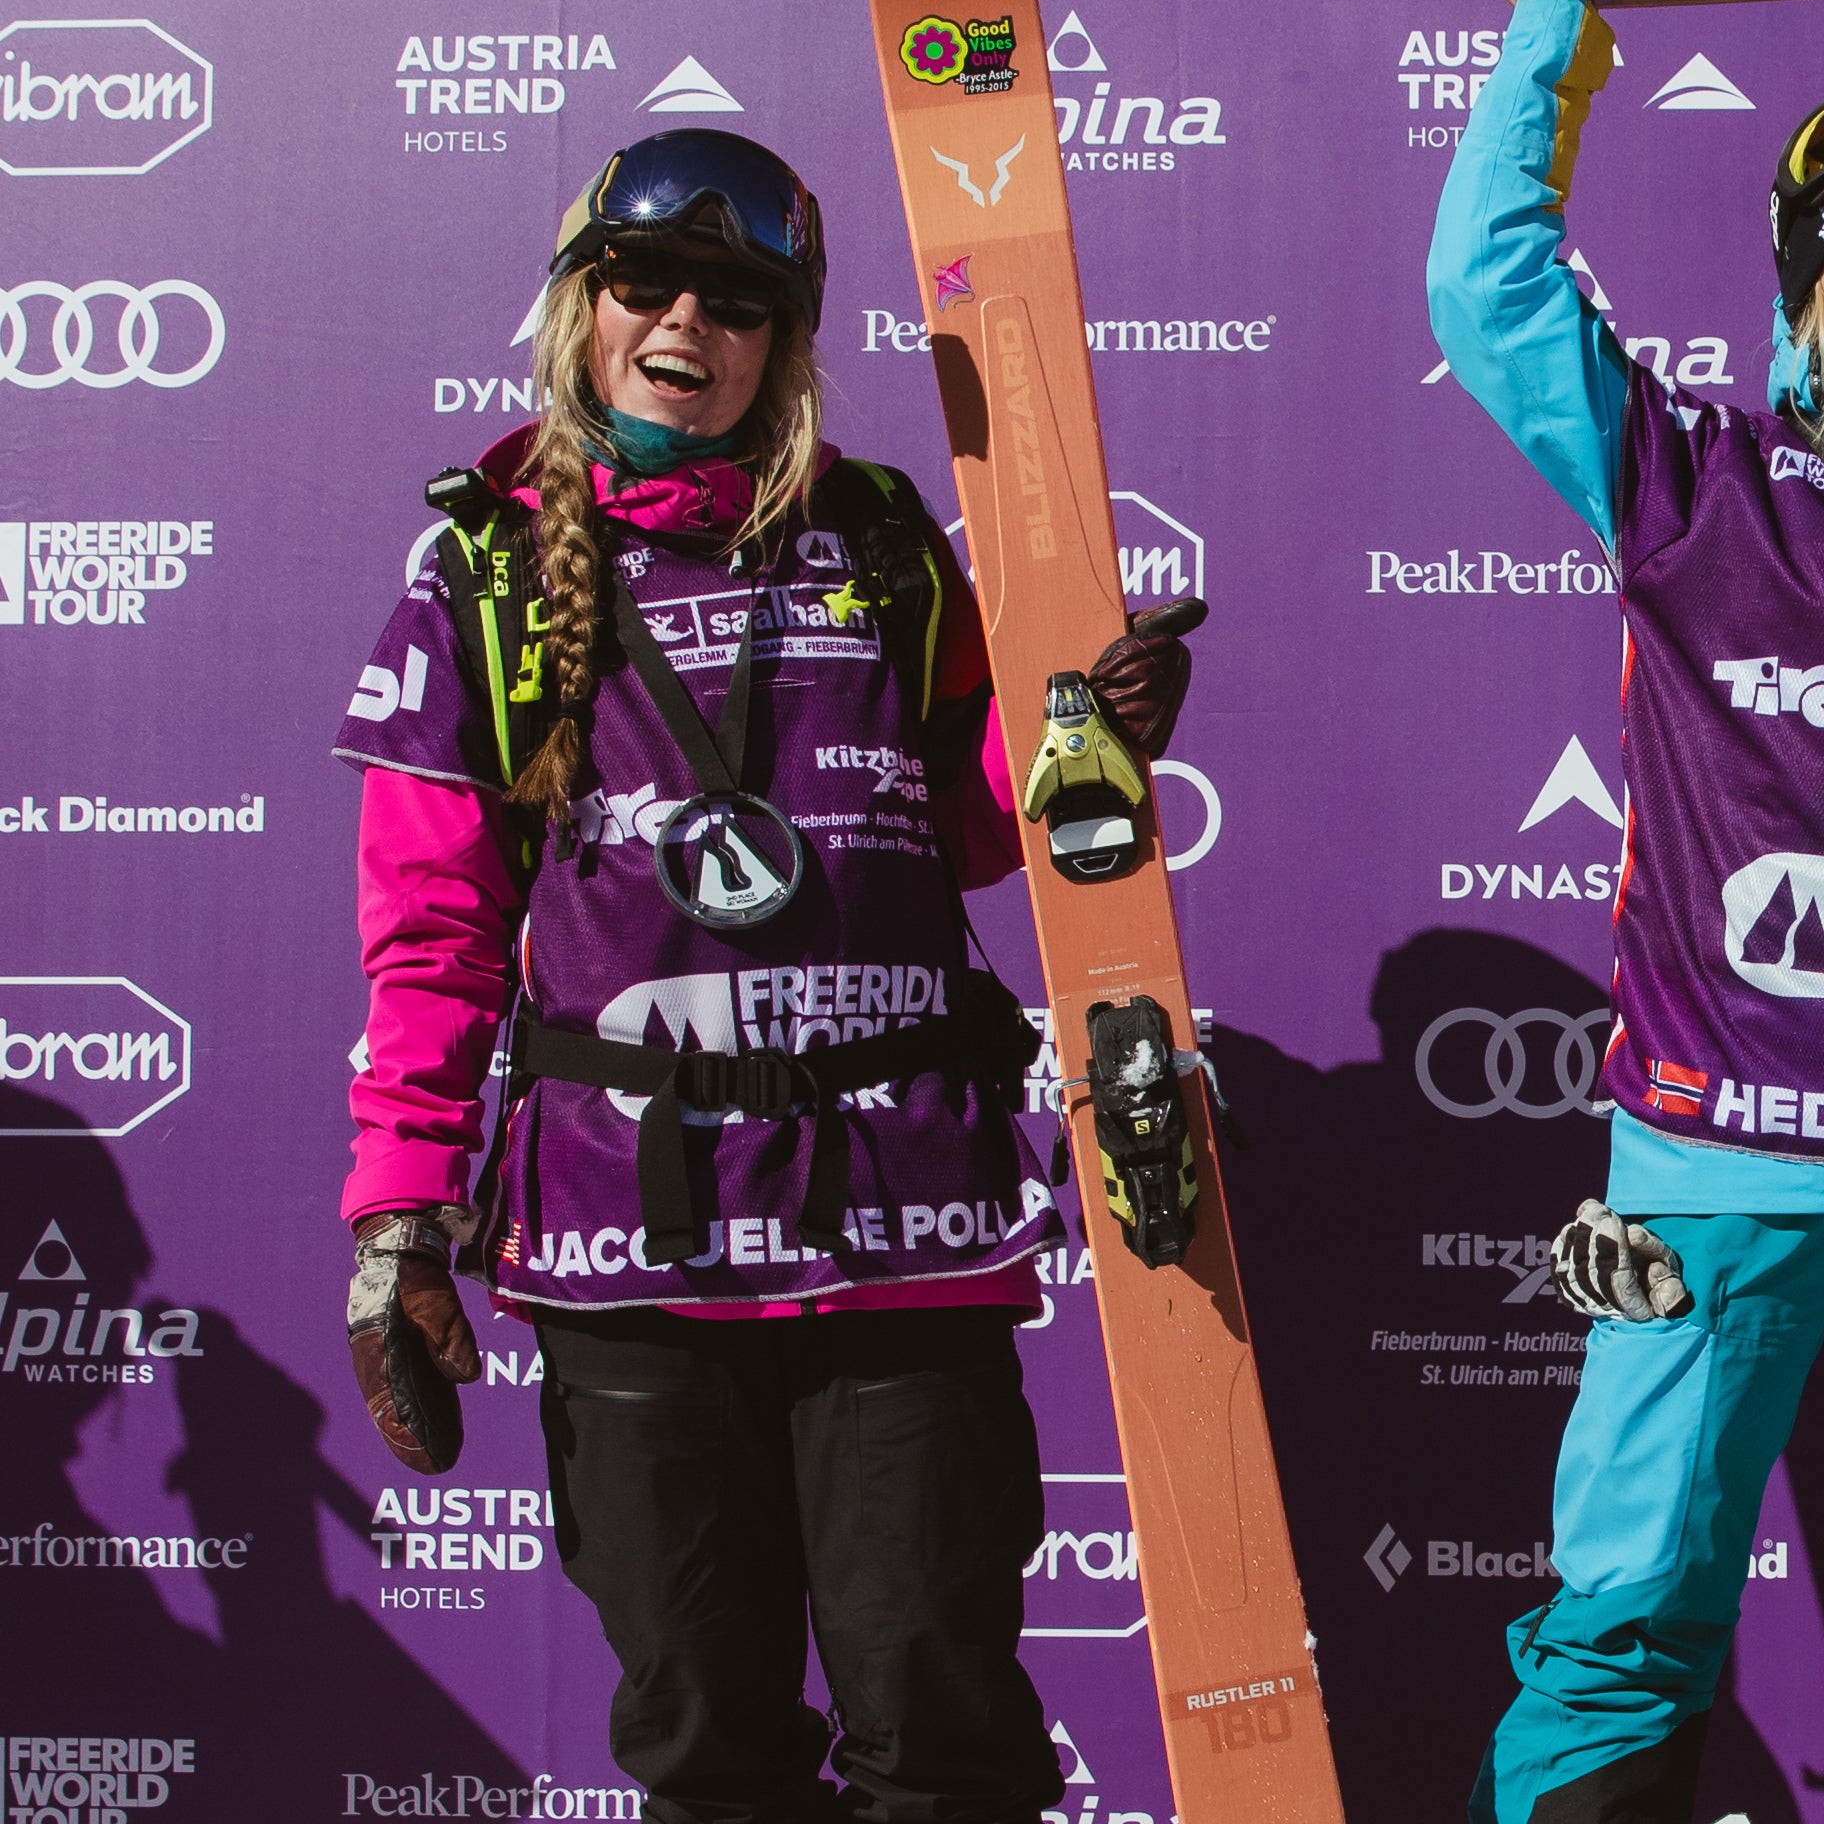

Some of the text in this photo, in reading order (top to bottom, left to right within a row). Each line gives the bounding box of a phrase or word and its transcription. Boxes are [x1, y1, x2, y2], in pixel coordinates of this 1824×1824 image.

[968, 19, 1010, 37] Good
[969, 37, 1012, 52] Vibes
[397, 35, 616, 72] AUSTRIA
[971, 51, 1006, 67] Only
[0, 51, 199, 123] ibram
[398, 79, 565, 115] TREND
[966, 82, 1009, 94] 1995-2015
[404, 131, 507, 153] HOTELS
[1061, 153, 1175, 172] ATCHES
[996, 318, 1058, 560] BLIZZARD
[29, 521, 213, 555] FREERIDE
[29, 556, 187, 590] WORLD
[492, 551, 511, 597] bca
[28, 590, 146, 624] TOUR
[60, 797, 264, 833] Diamond
[0, 1019, 177, 1080] bram
[1372, 1331, 1486, 1354] Fieberbrunn
[25, 1364, 155, 1384] WATCHES
[1450, 1364, 1502, 1387] Ulrich
[1508, 1370, 1538, 1387] am
[372, 1488, 554, 1527] AUSTRI
[371, 1533, 544, 1571] TREND
[1427, 1540, 1558, 1579] Black
[381, 1587, 486, 1609] HOTELS
[1186, 1677, 1295, 1711] RUSTLER 11
[10, 1736, 195, 1773] FREERIDE
[11, 1773, 169, 1808] WORLD
